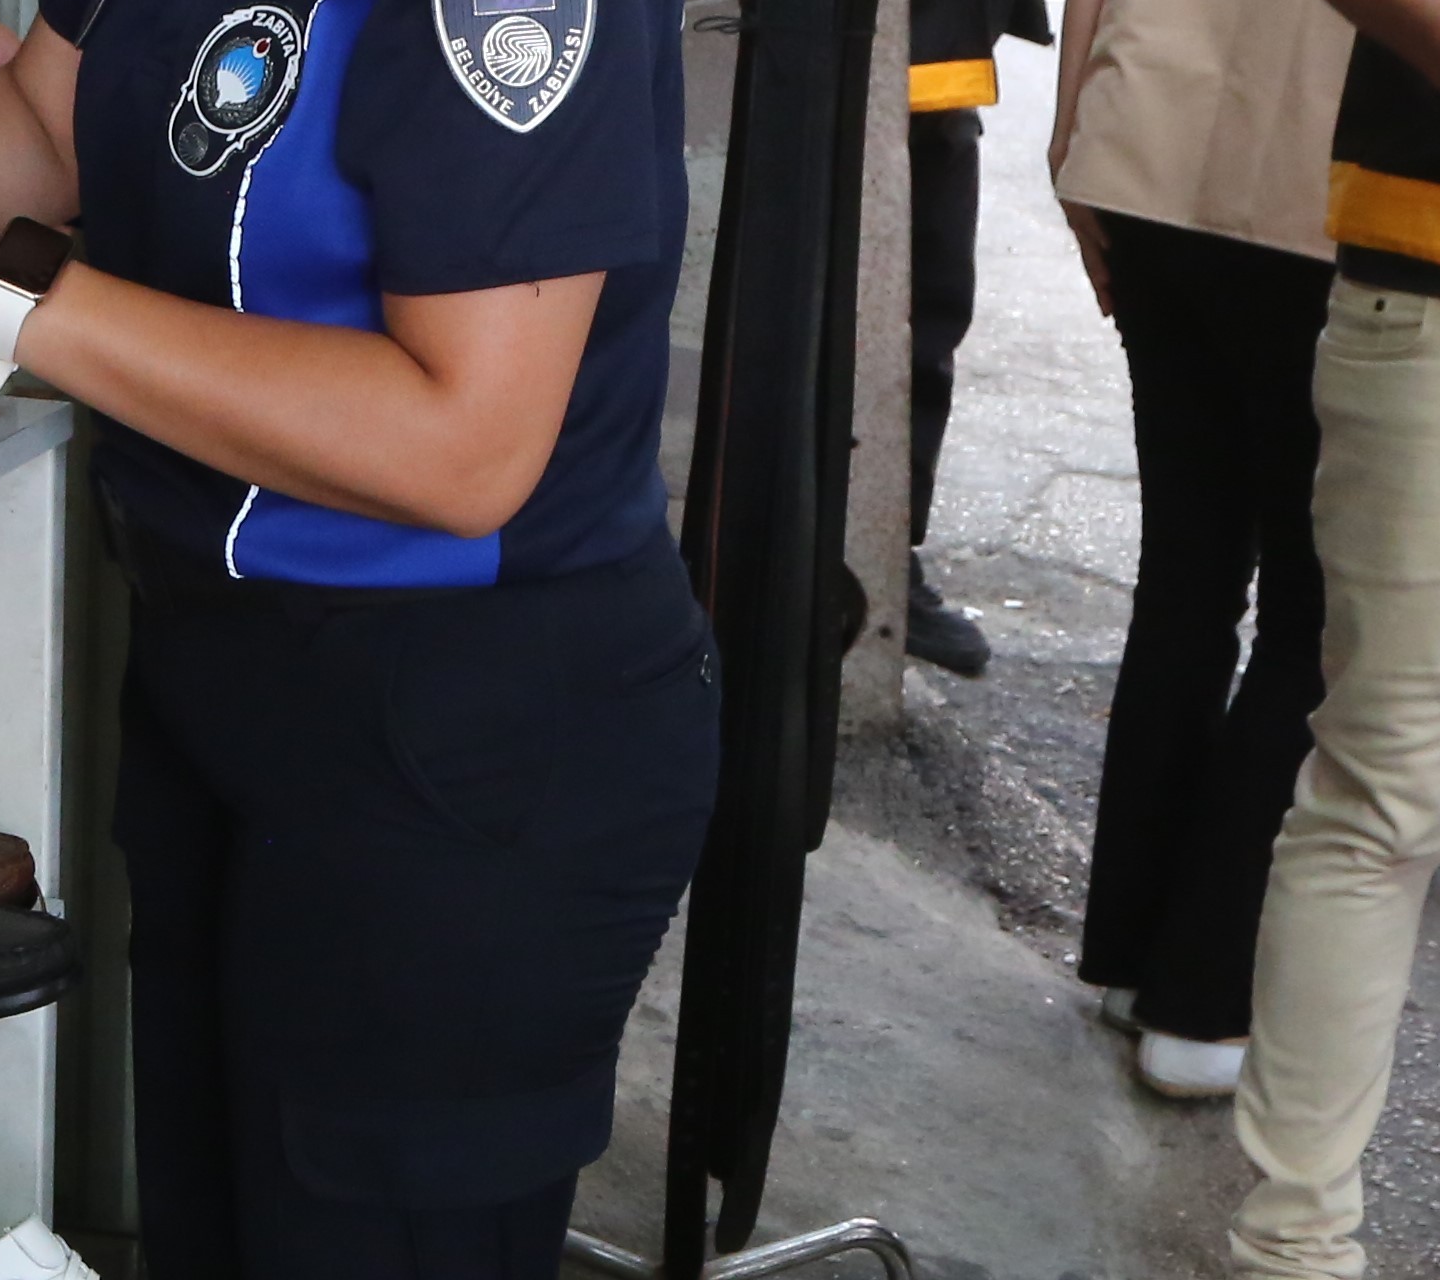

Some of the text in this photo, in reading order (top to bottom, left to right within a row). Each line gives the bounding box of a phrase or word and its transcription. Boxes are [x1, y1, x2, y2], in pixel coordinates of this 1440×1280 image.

[252, 12, 296, 58] ZABITA
[451, 27, 582, 115] BELEDİYE ZABITASI
